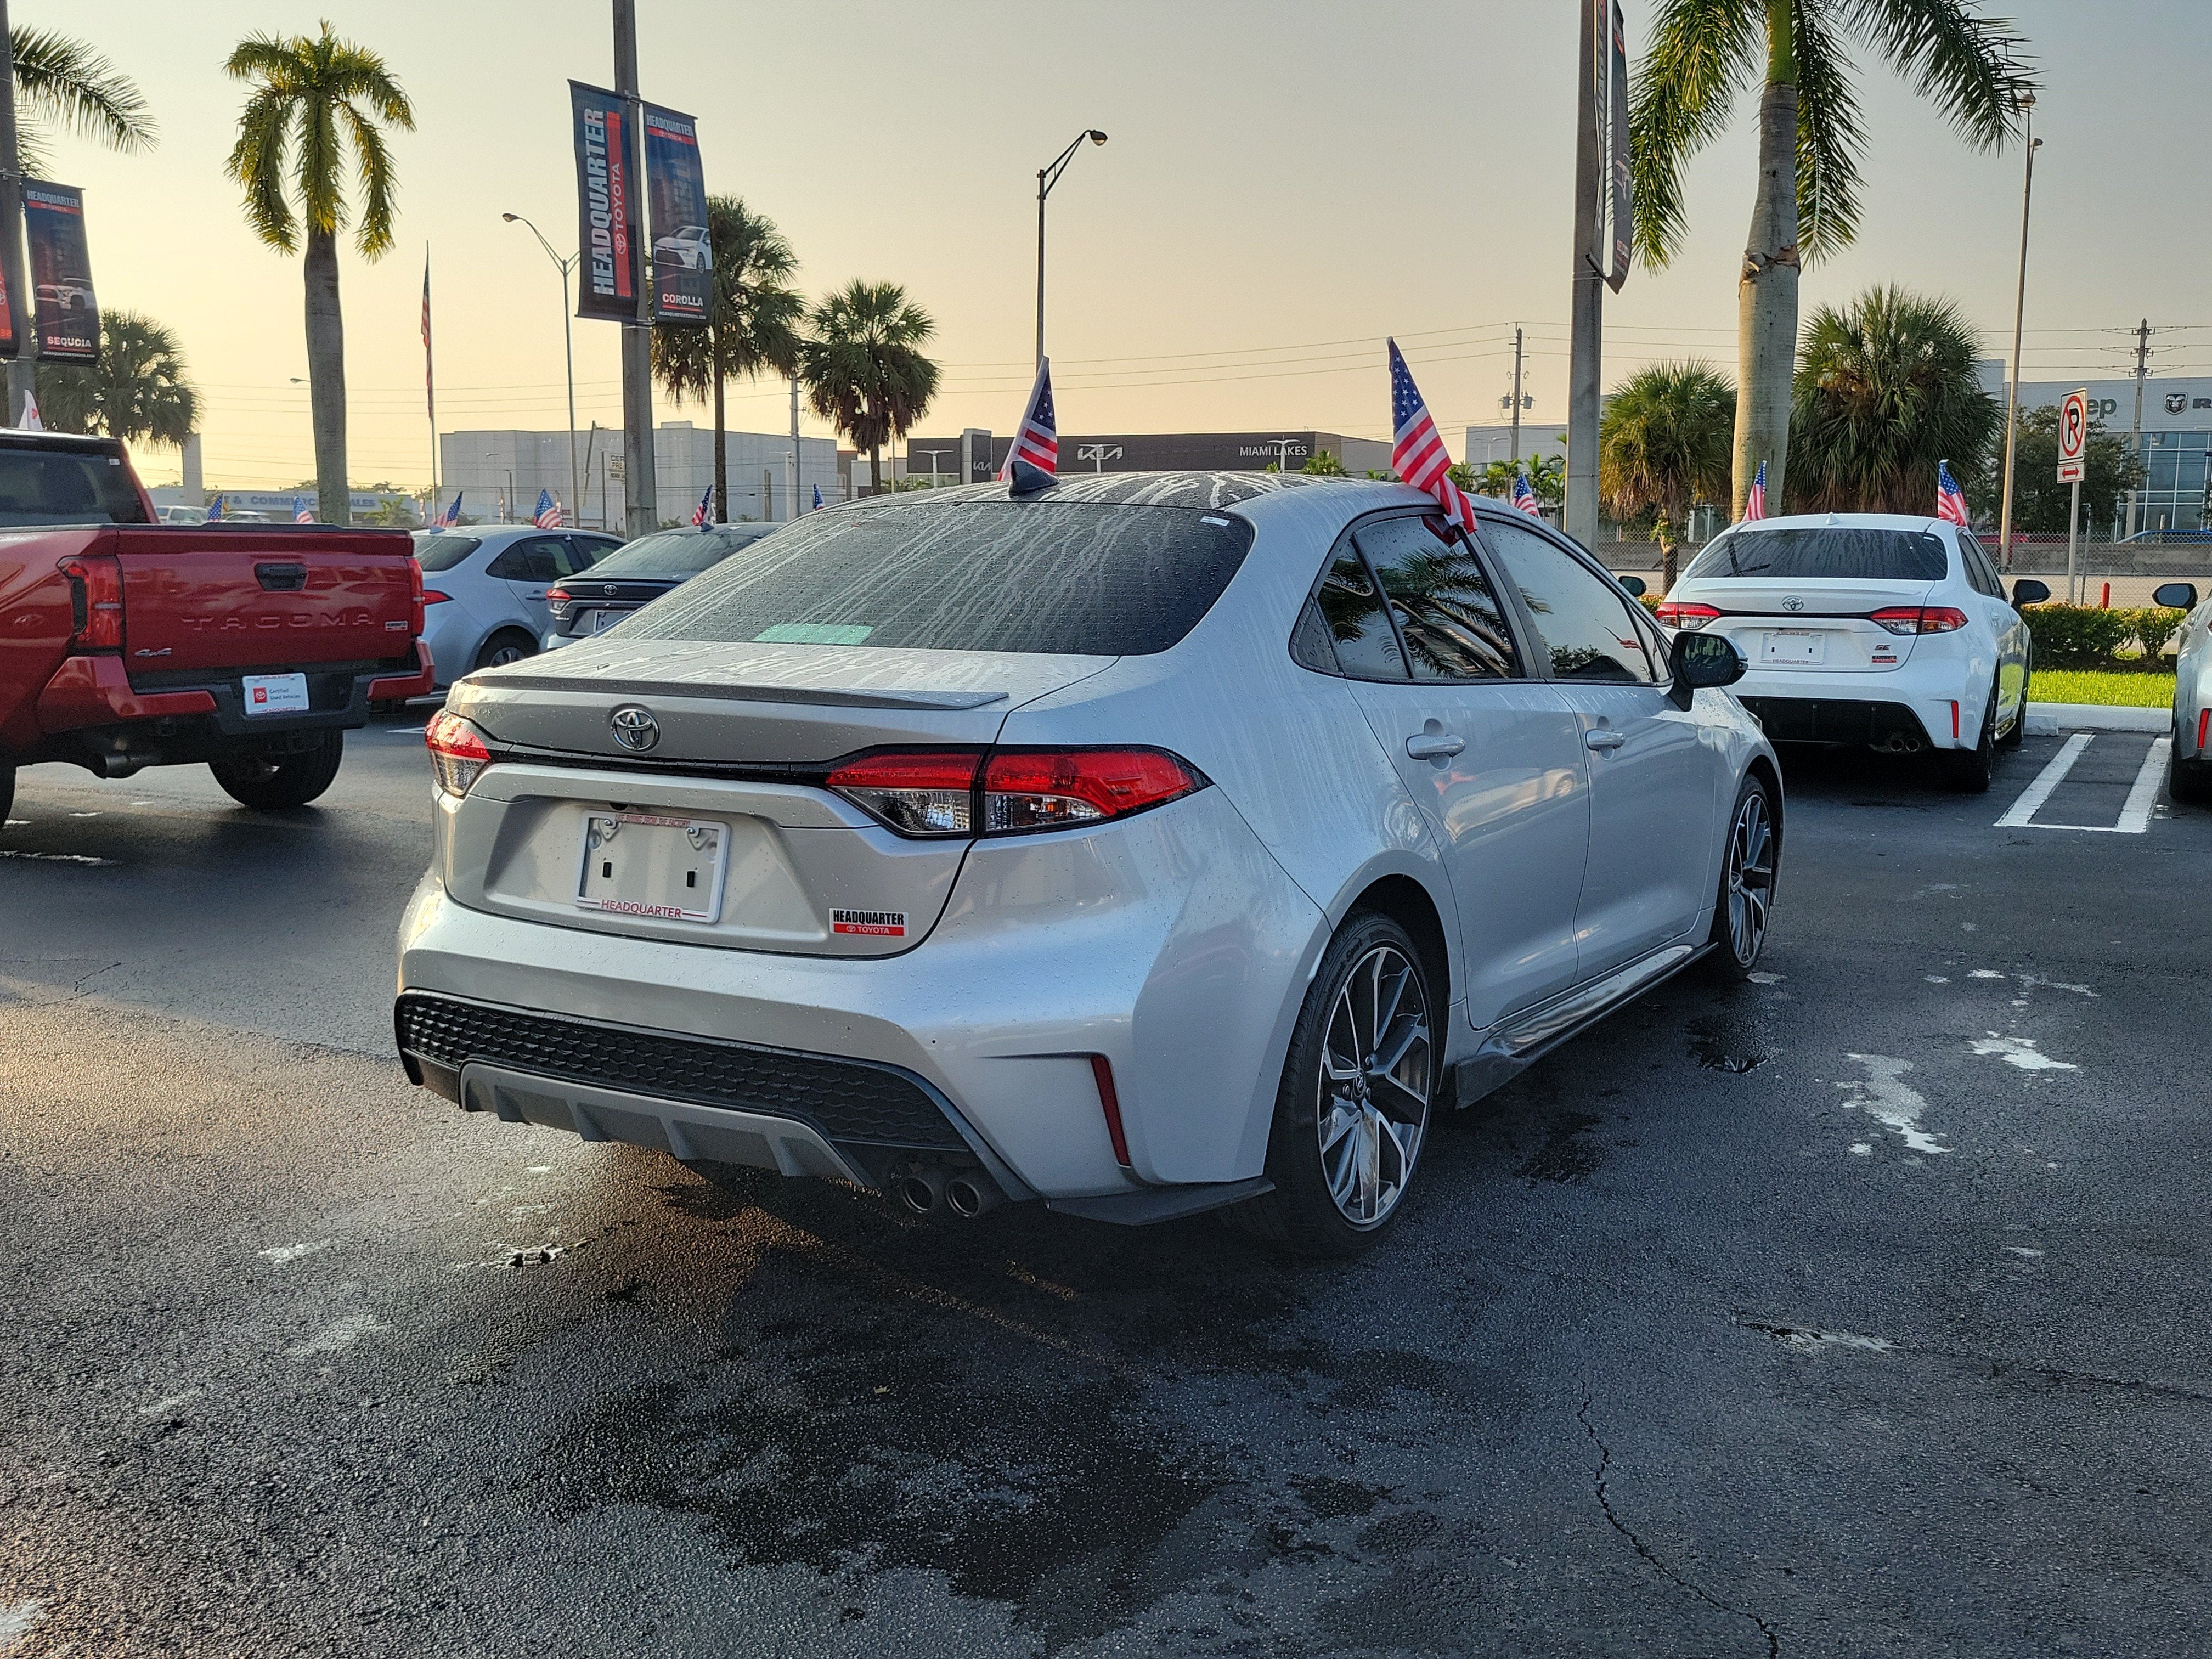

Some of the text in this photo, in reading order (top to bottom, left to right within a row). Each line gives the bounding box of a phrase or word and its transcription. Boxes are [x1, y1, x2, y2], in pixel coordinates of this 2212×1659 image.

[646, 114, 694, 137] HEADQUARTER
[26, 190, 80, 208] HEADQUARTER
[583, 108, 614, 296] HEADQUARTER
[610, 163, 625, 232] TOYOTA
[662, 293, 703, 307] COROLLA
[47, 336, 92, 348] SEQUOIA
[1077, 447, 1123, 460] KIA
[1239, 445, 1307, 456] MIAMI LAKES
[973, 461, 991, 471] KIA
[181, 612, 375, 630] TACOMA
[601, 899, 681, 918] HEADQUARTER
[833, 910, 904, 926] HEADQUARTER
[857, 926, 890, 934] TOYOTA
